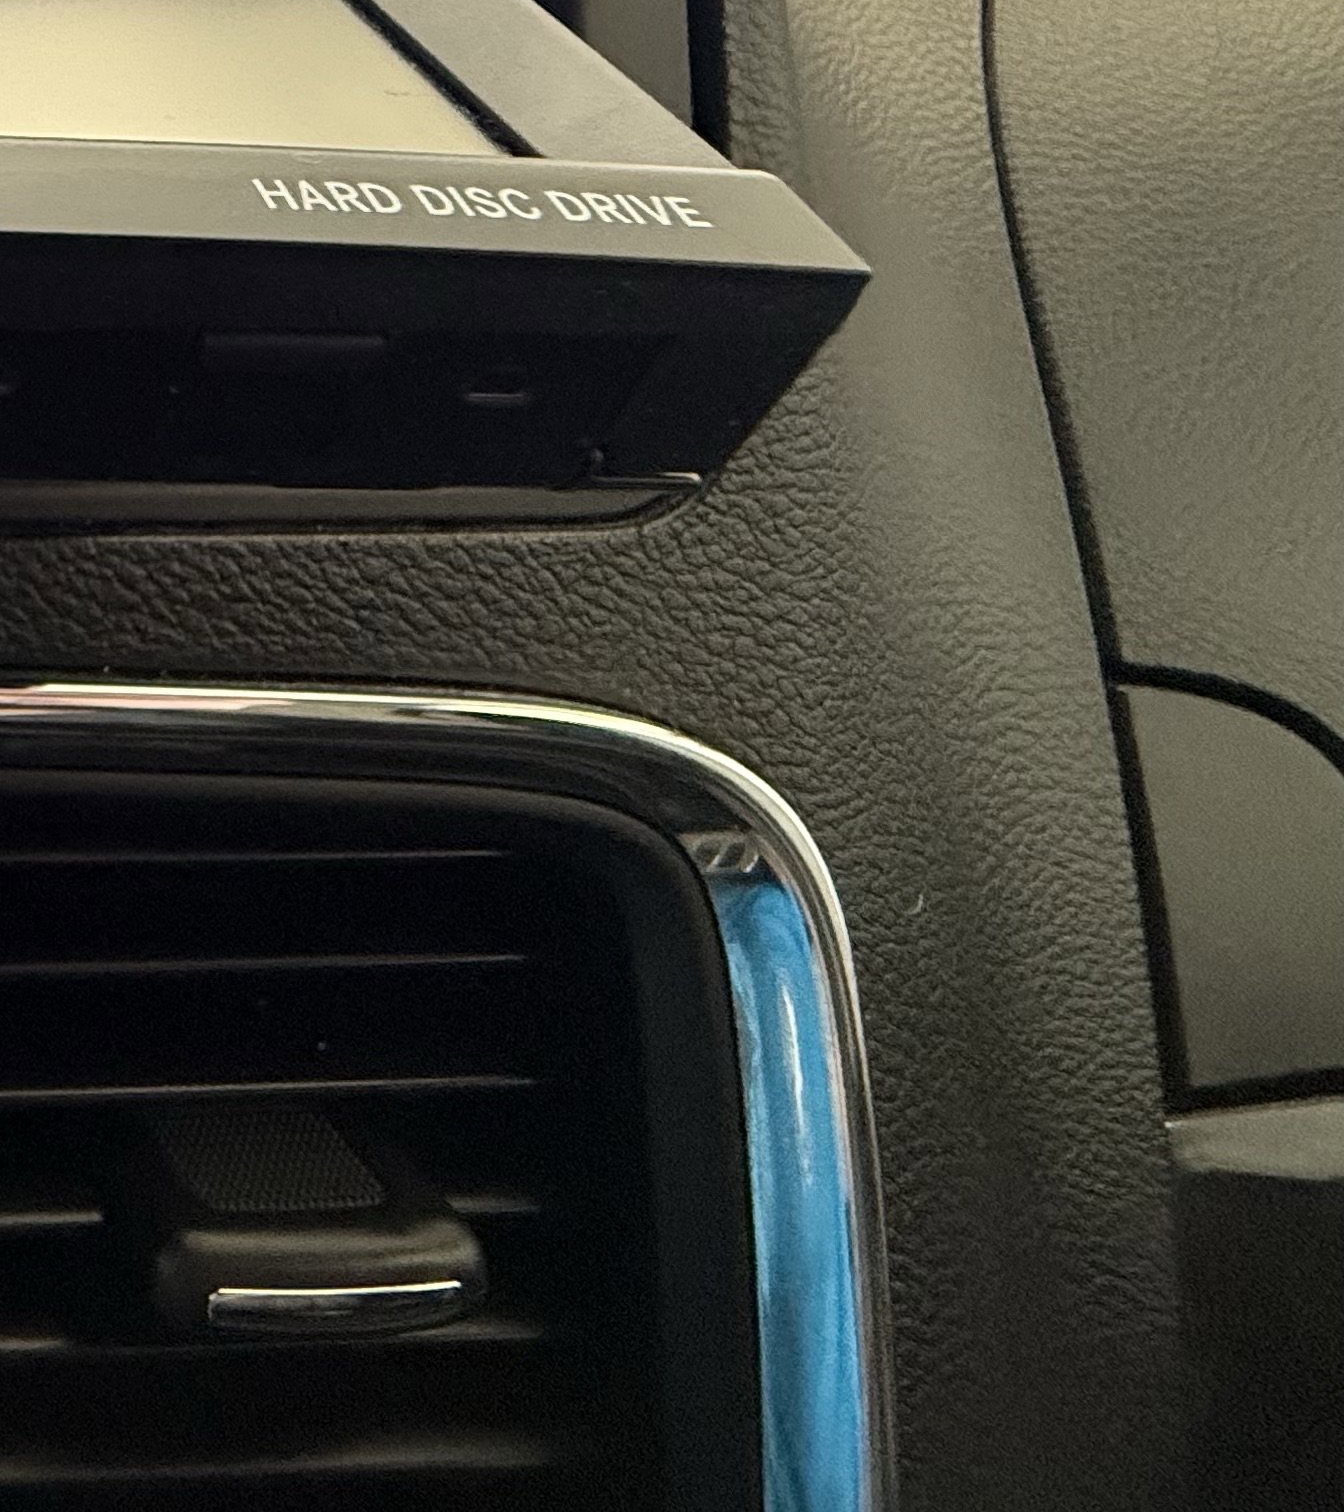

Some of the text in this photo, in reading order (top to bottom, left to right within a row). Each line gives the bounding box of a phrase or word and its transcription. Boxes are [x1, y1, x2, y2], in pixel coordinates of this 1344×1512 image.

[251, 177, 714, 229] HARD DISC DRIVE
